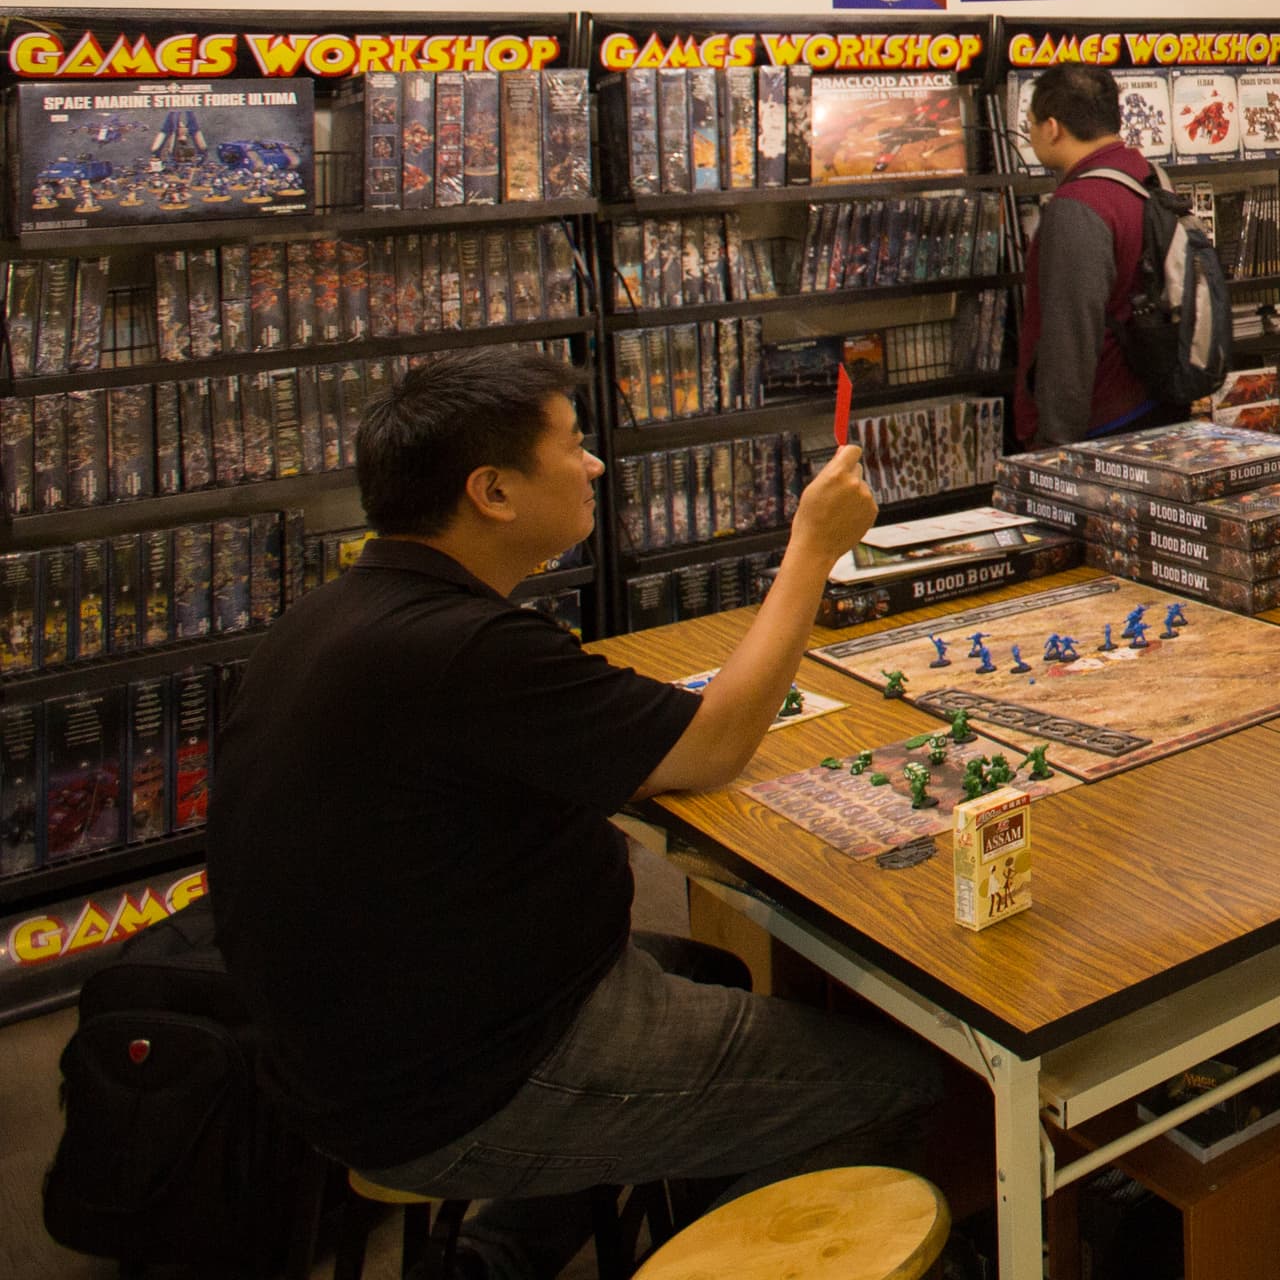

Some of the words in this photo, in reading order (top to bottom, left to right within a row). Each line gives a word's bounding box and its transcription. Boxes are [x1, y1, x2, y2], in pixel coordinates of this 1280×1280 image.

[9, 30, 237, 78] GAMES
[244, 31, 560, 75] WORKSHOP
[601, 31, 756, 72] GAMES
[760, 31, 985, 72] WORKSHOP
[1009, 32, 1122, 68] GAMES
[812, 76, 897, 90] ORMCLOUD
[899, 74, 953, 87] ATTACK
[44, 95, 93, 111] SPACE
[94, 94, 152, 110] MARINE
[153, 94, 202, 108] STRIKE
[204, 93, 246, 107] FORCE
[247, 91, 298, 106] ULTIMA
[1029, 470, 1054, 490] BLOOD
[1055, 476, 1079, 497] BOWL
[1094, 458, 1122, 478] BLOOD
[1123, 464, 1151, 485] BOWL
[1230, 464, 1263, 482] BLOOD
[1026, 498, 1052, 518] BLOOD
[1052, 504, 1077, 526] BOWL
[1149, 501, 1178, 522] BLOOD
[1179, 508, 1208, 530] BOWL
[1150, 531, 1179, 551] BLOOD
[1179, 537, 1209, 561] BOWL
[913, 573, 965, 598] BLOOD
[967, 561, 1015, 585] BOWL
[1151, 560, 1179, 582] BLOOD
[1179, 568, 1210, 592] BOWL
[985, 825, 1022, 853] ASSAM
[7, 868, 208, 966] GAME
